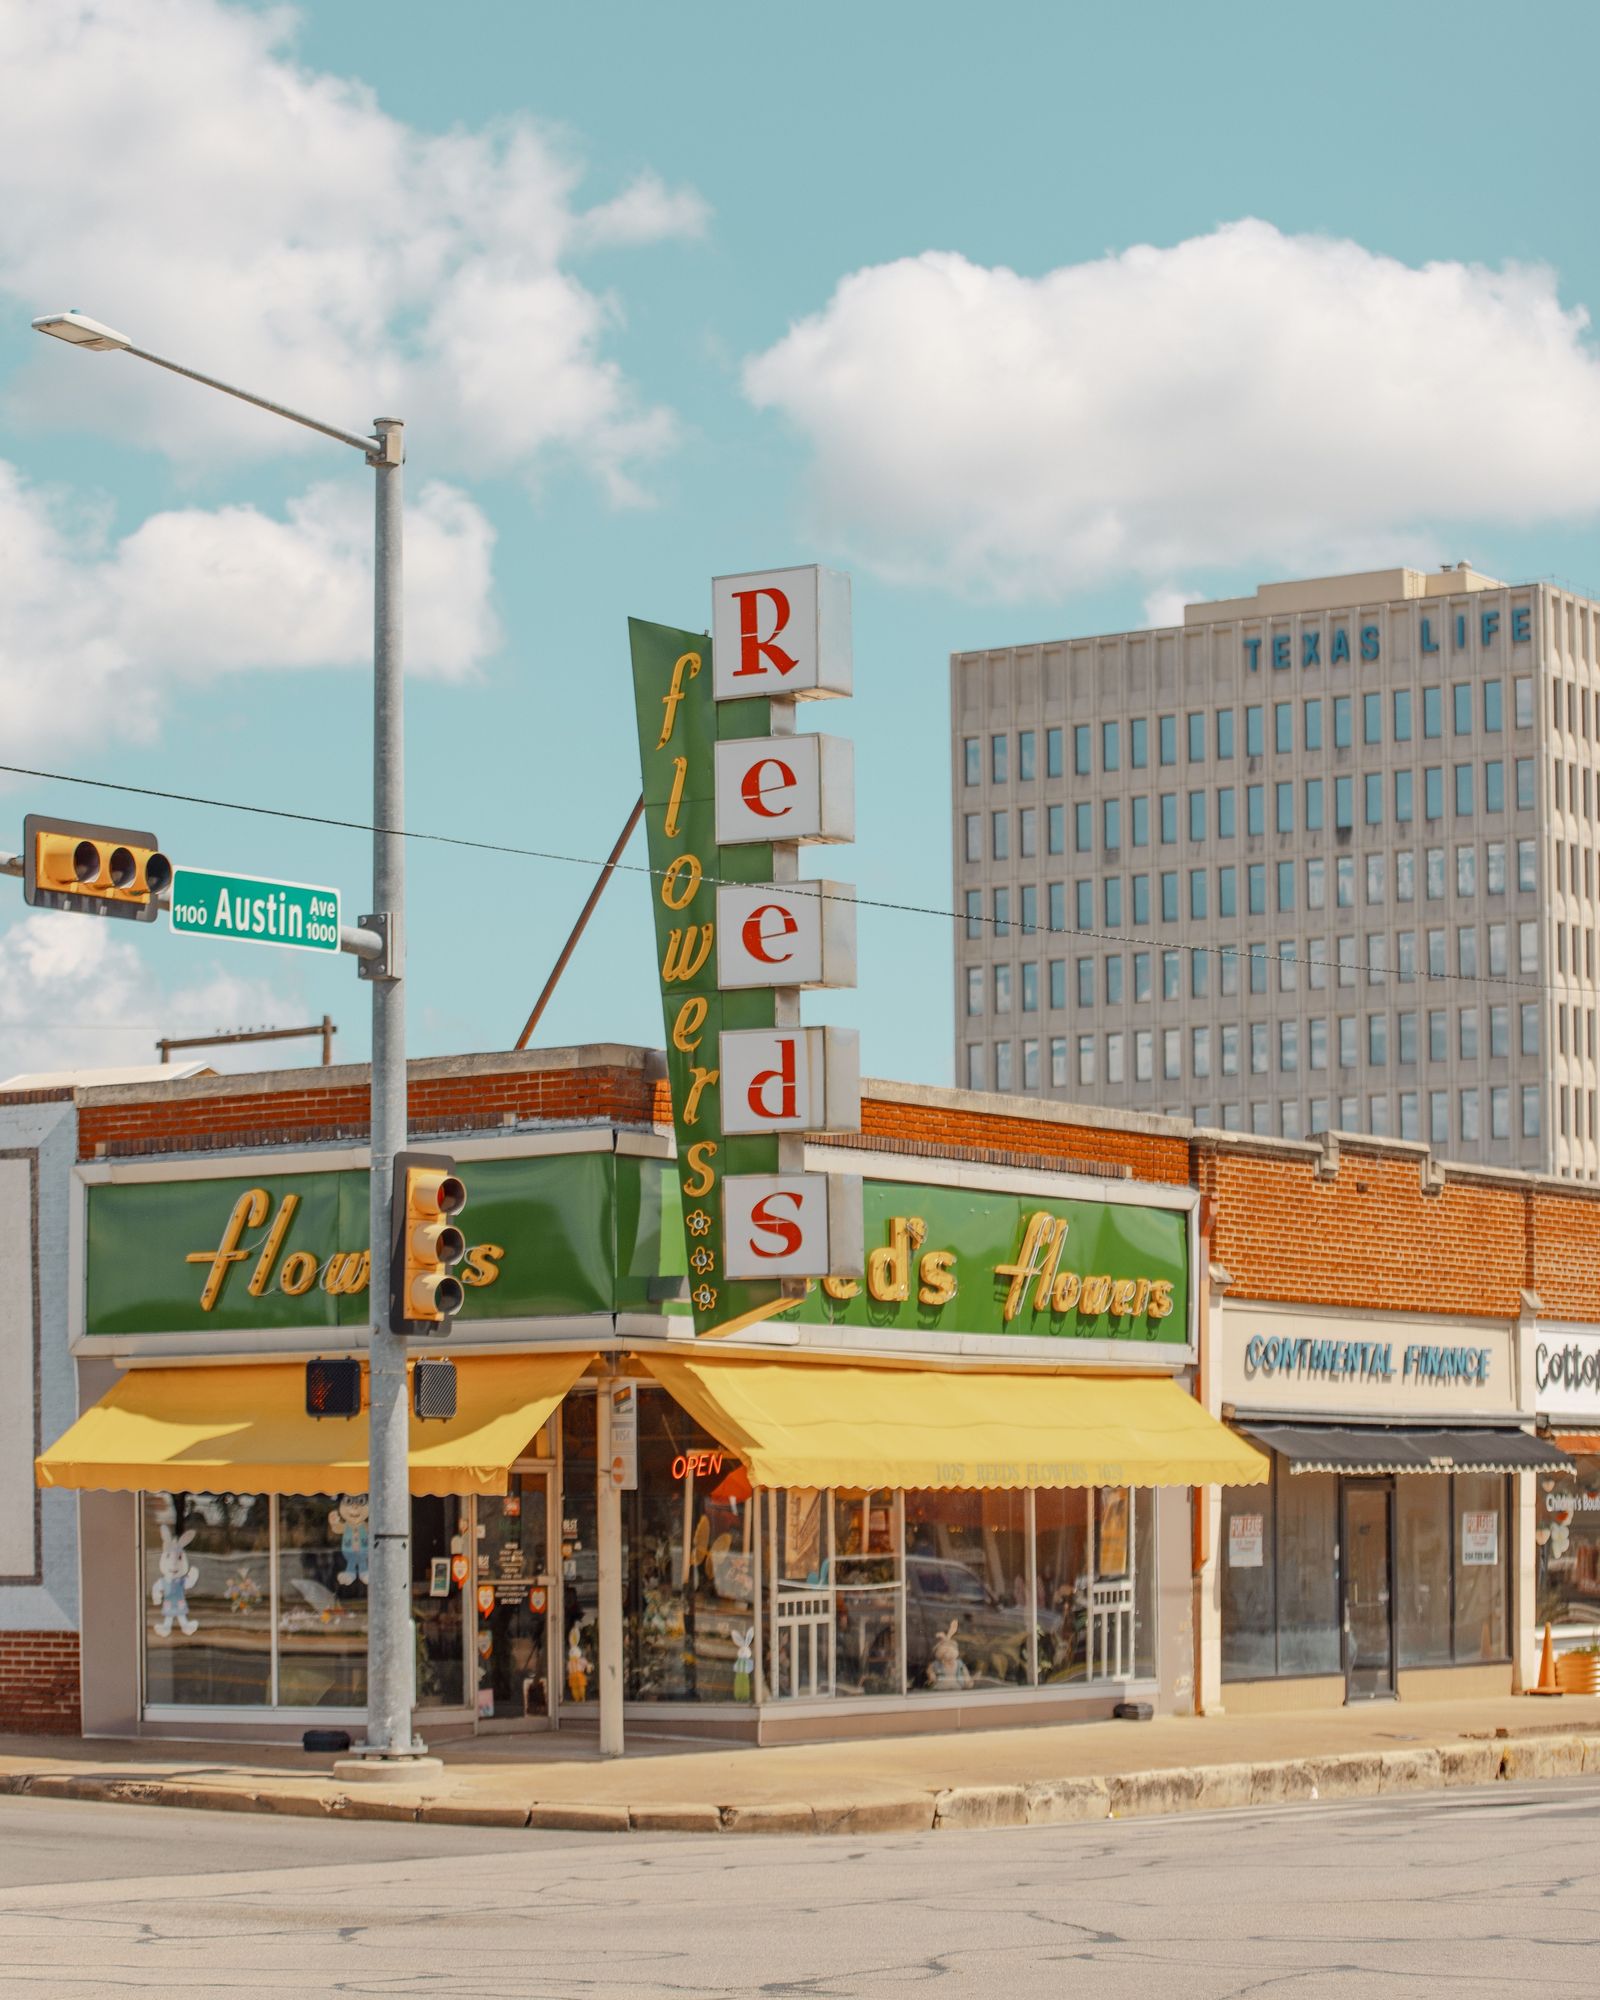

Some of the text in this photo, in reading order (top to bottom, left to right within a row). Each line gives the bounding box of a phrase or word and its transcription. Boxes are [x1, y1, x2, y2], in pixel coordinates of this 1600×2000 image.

[1244, 608, 1533, 673] TEXAS LIFE
[174, 887, 336, 939] 1100 Austin Ave
[306, 922, 337, 943] 1000
[655, 652, 720, 1198] flowers
[185, 1188, 504, 1312] flows
[994, 1211, 1174, 1322] flowers
[1247, 1334, 1492, 1380] CONTINENTAL FINANCE
[671, 1453, 723, 1480] OPEN
[1025, 1464, 1088, 1482] FLOWERS
